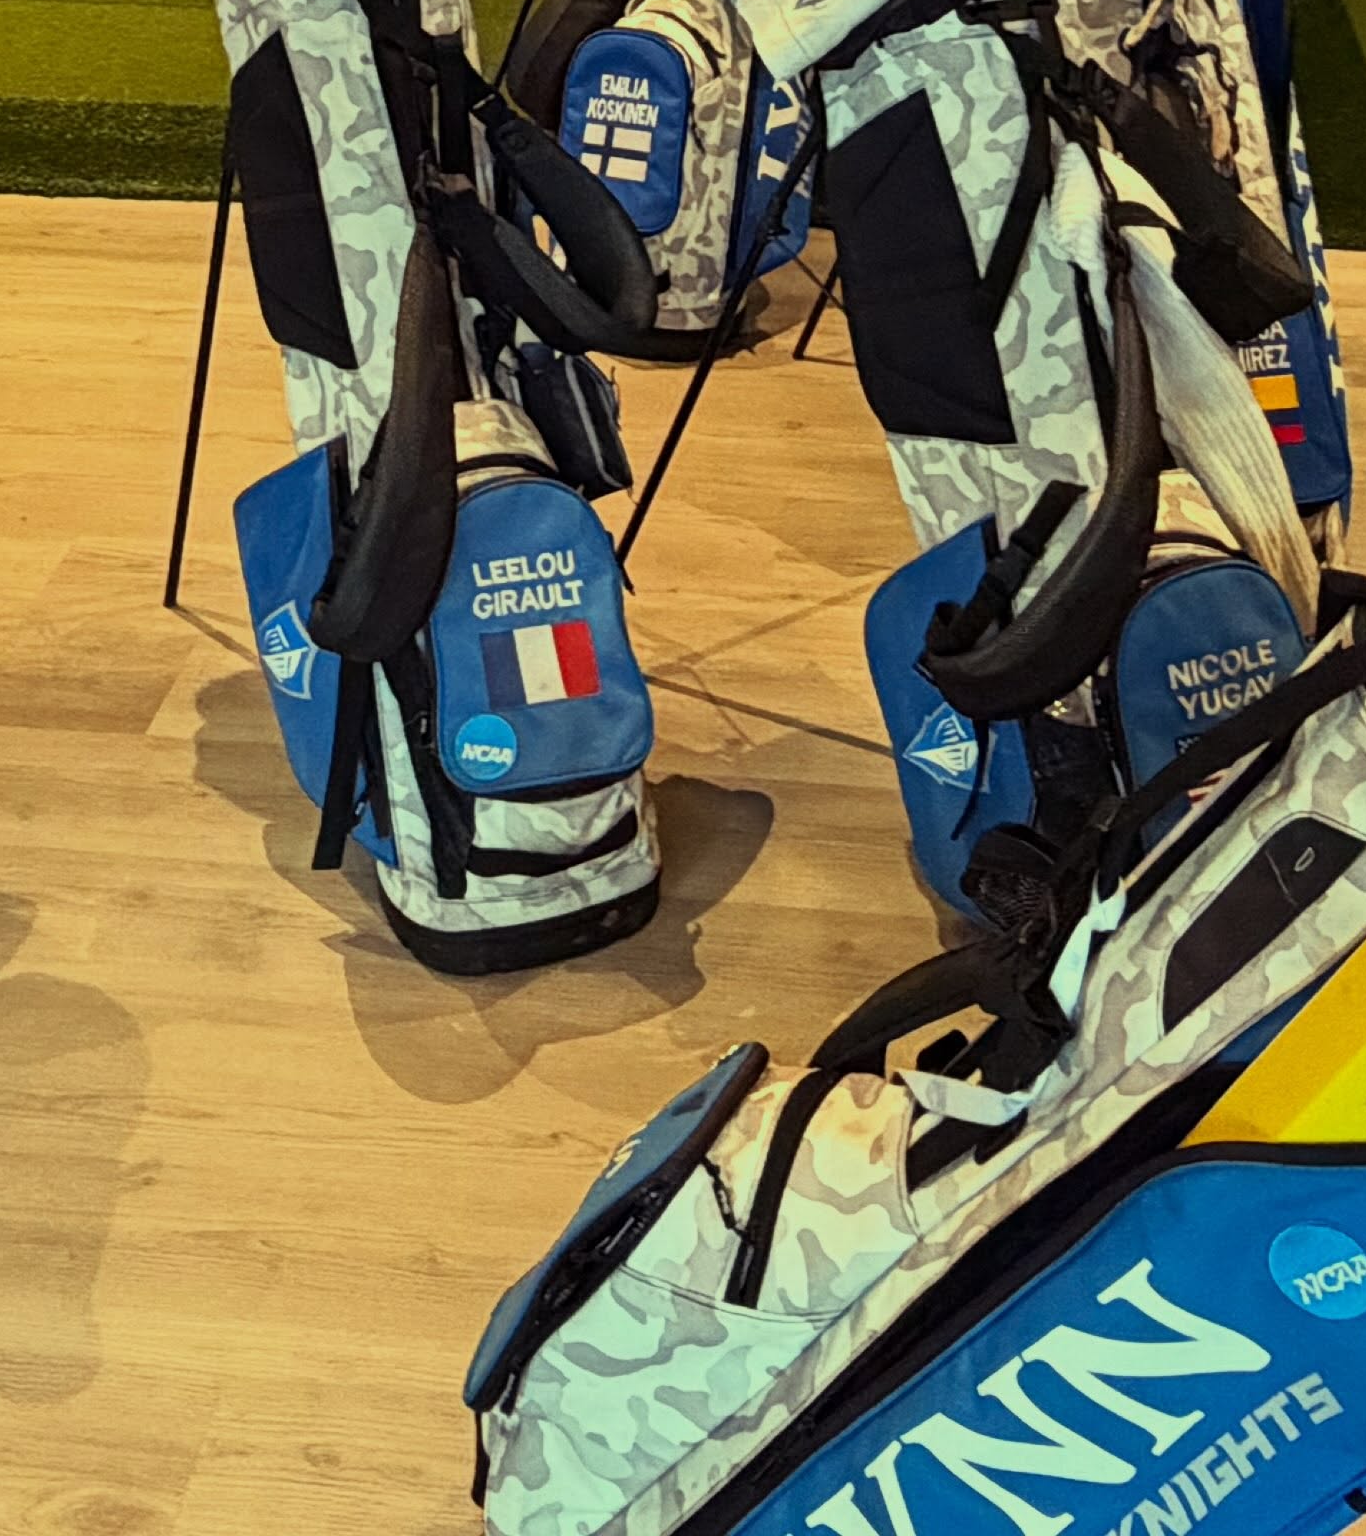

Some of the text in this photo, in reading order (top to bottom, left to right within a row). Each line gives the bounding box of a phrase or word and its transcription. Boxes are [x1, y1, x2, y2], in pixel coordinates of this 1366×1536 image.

[600, 74, 650, 101] EMILIA
[586, 98, 660, 128] KOSKINEN
[472, 550, 576, 588] LEELOU
[472, 579, 585, 620] GIRAULT
[1166, 639, 1277, 691] NICOLE
[1176, 672, 1277, 721] YUGAY
[461, 741, 515, 766] NCAA
